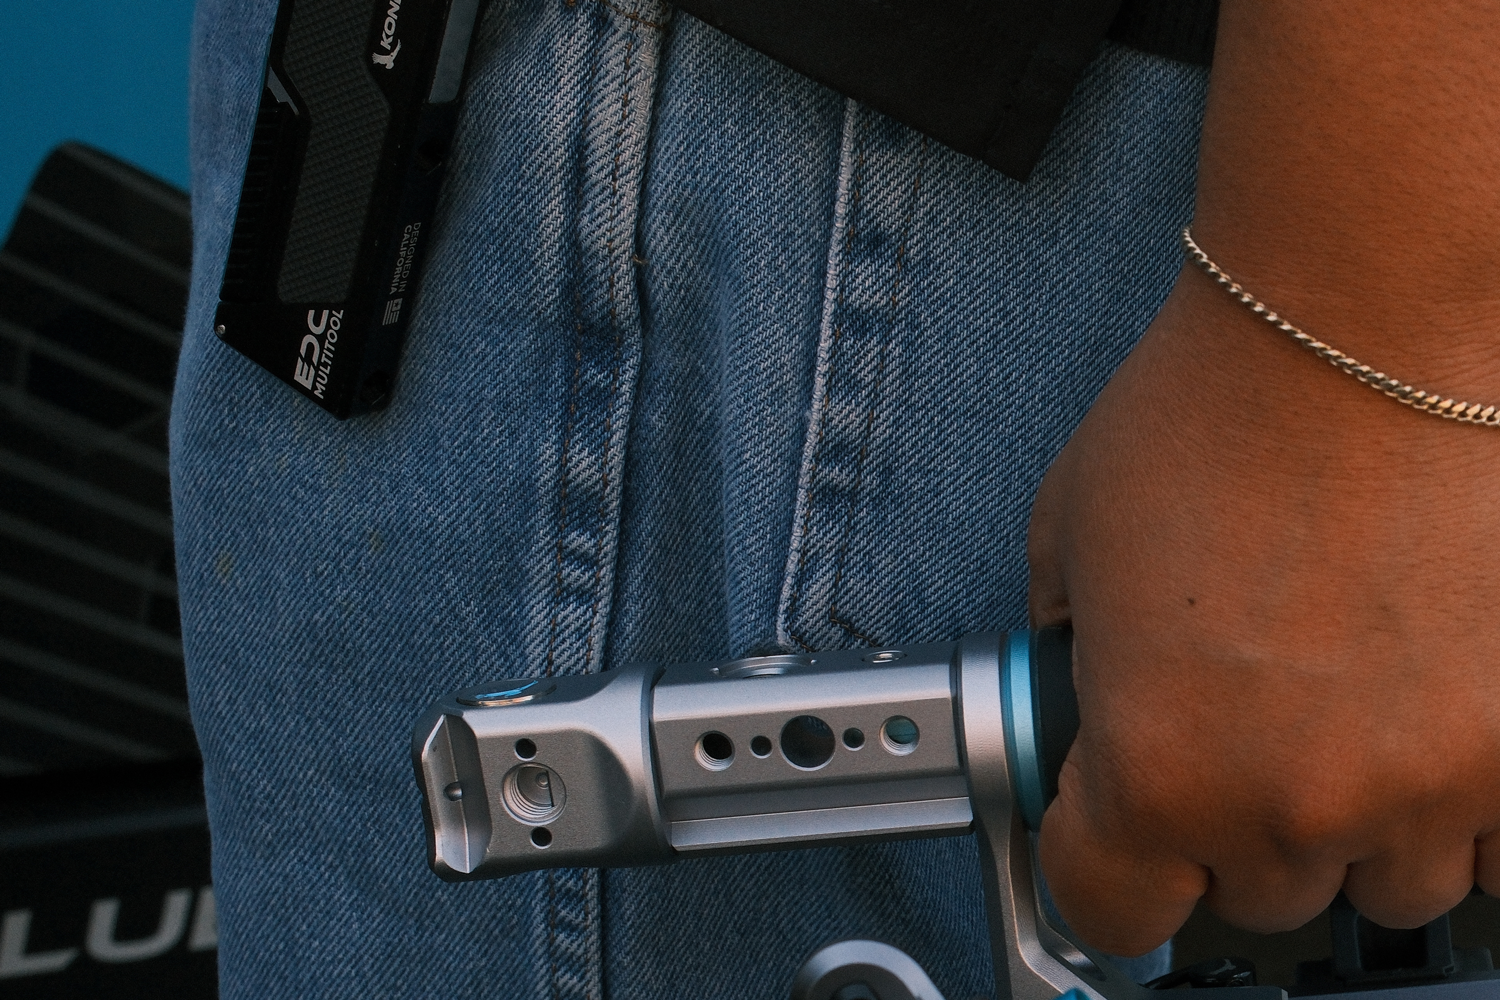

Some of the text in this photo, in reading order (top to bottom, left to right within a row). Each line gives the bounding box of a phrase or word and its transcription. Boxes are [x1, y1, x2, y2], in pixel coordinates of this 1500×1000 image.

[390, 224, 412, 296] CALIFORNIA
[398, 222, 422, 293] DESIGNED IN
[293, 310, 330, 391] EDC
[314, 310, 344, 400] MULTITOOL
